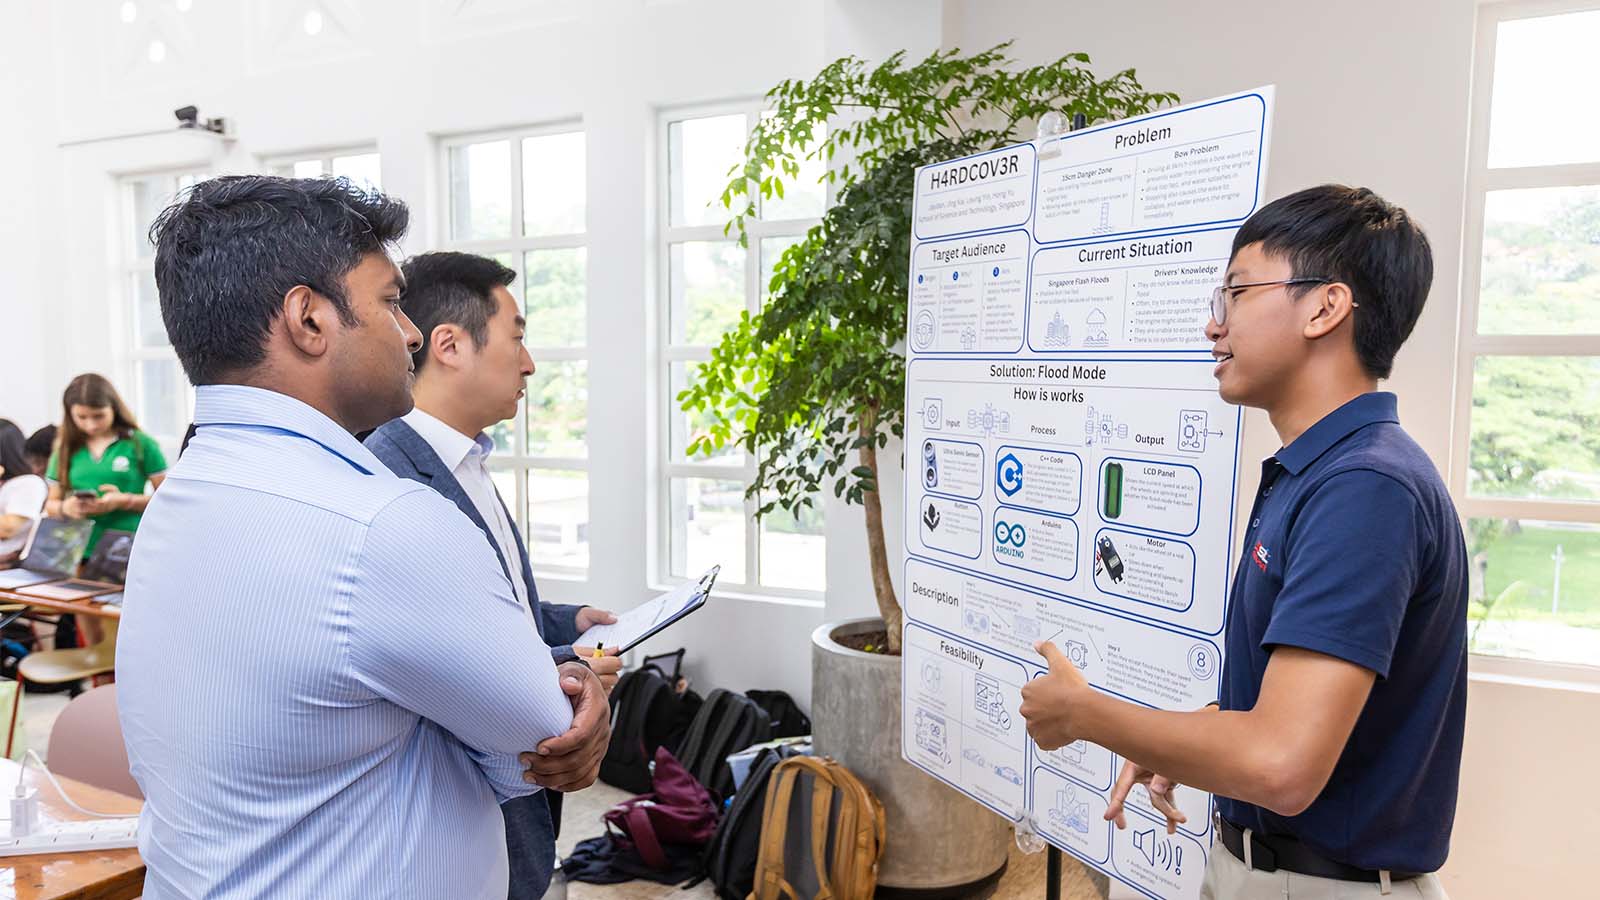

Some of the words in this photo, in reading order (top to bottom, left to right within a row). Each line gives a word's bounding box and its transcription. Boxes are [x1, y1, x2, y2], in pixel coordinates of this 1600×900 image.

[1114, 127, 1171, 149] Problem
[1174, 150, 1188, 159] Bow
[1190, 144, 1220, 156] Problem
[930, 154, 1018, 190] H4RDCOV3R
[1062, 173, 1076, 182] 15cm
[1077, 170, 1096, 180] Danger
[1098, 167, 1112, 176] Zone
[932, 248, 959, 263] Target
[961, 243, 1006, 258] Audience
[1078, 246, 1126, 263] Current
[1129, 238, 1193, 258] Situation
[1154, 268, 1180, 277] Drivers'
[1180, 265, 1218, 276] Knowledge
[1048, 278, 1074, 288] Singapore
[1075, 278, 1090, 286] Flash
[1090, 276, 1110, 284] Floods
[990, 364, 1036, 378] Solution:
[1038, 365, 1069, 379] Flood
[1072, 366, 1106, 380] Mode
[1014, 387, 1037, 401] How
[1039, 388, 1047, 401] is
[1050, 389, 1084, 403] works
[945, 419, 960, 428] Input
[1030, 425, 1057, 436] Process
[1135, 434, 1165, 446] Output
[966, 450, 980, 458] Sensor
[1050, 456, 1064, 464] Code
[1000, 459, 1022, 491] C++
[1143, 467, 1156, 476] LCD
[1157, 470, 1176, 478] Panel
[1041, 520, 1062, 529] Arduino
[1147, 538, 1166, 548] Motor
[995, 545, 1025, 559] ARDUINO
[912, 582, 959, 607] Description
[940, 640, 985, 670] Feasibility
[1197, 652, 1206, 668] 8
